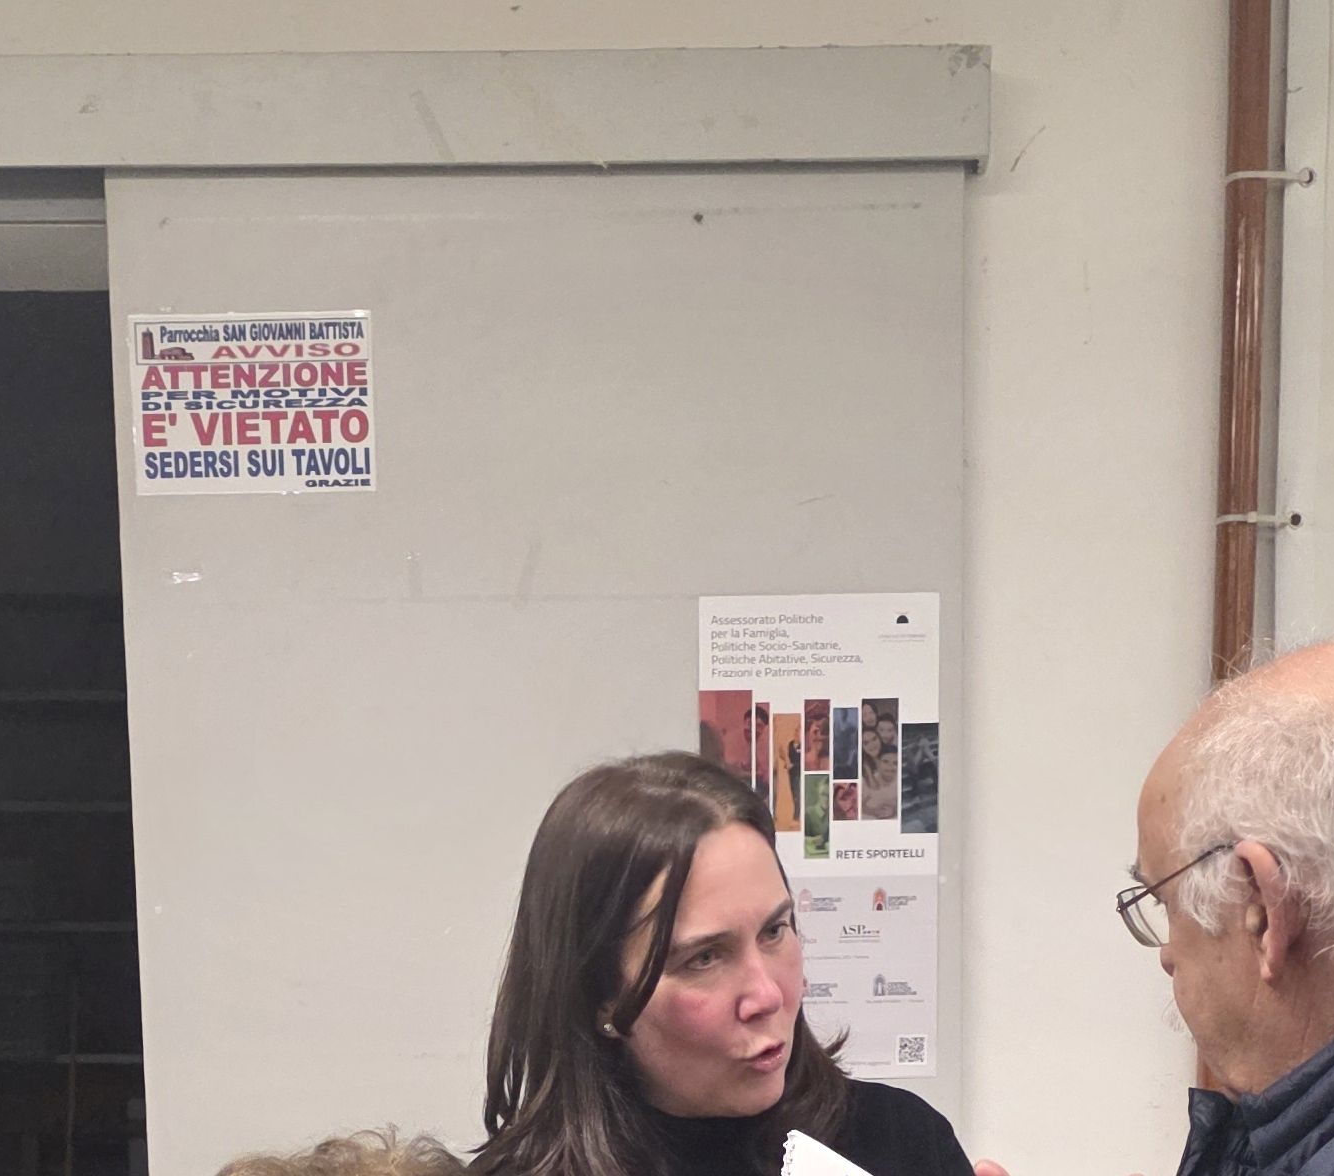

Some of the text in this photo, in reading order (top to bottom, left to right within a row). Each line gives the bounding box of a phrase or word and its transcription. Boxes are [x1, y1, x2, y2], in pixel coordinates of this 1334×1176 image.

[159, 321, 363, 343] Parrocchia SAN GIOVANNI BATTISTA
[210, 343, 360, 359] AVVISO
[140, 362, 366, 390] ATTENZIONE
[141, 386, 367, 400] PER MOTIVI
[141, 397, 367, 411] DI SICUREZZA
[141, 410, 368, 447] E' VIETATO
[143, 446, 370, 479] SEDERSI SUI TAVOLI
[304, 477, 370, 487] GRAZIE
[710, 613, 823, 625] Assessorato Politiche
[710, 627, 788, 640] per la Famiglia,
[710, 640, 840, 652] Politiche Socio-Sanitarie,
[711, 652, 862, 665] Politiche Abitative, Sicurezza,
[711, 666, 824, 678] Frazioni e Patrimonio.
[835, 848, 923, 859] RETE SPORTELLI
